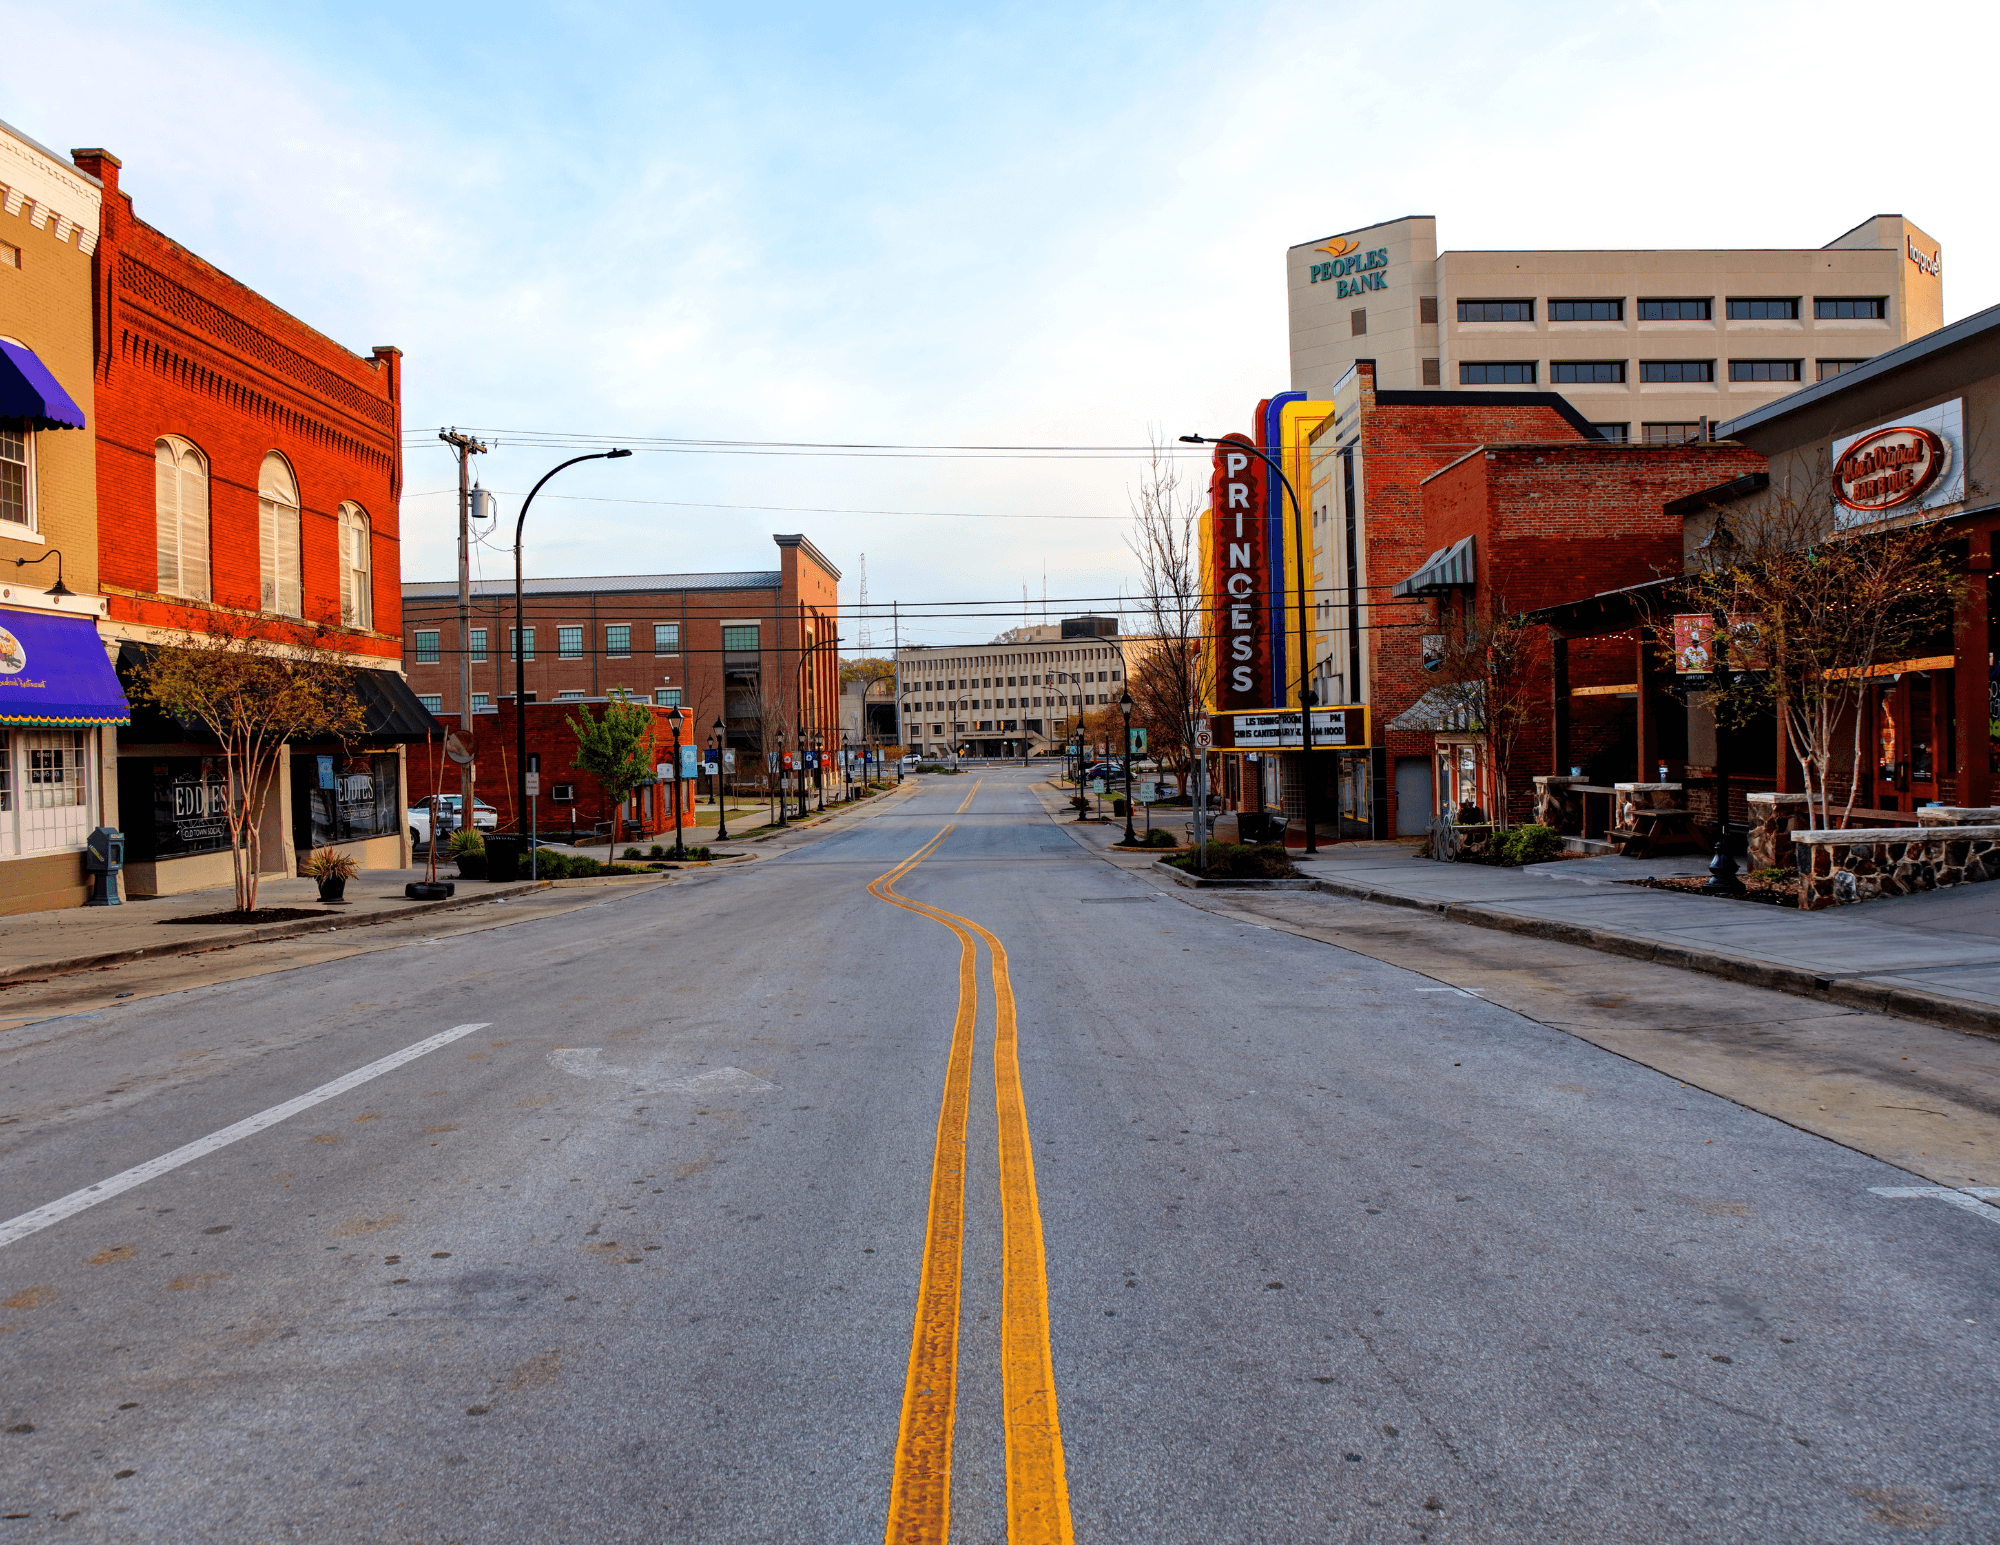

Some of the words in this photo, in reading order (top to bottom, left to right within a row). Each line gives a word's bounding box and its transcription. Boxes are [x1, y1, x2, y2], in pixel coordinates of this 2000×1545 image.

[1310, 247, 1388, 284] PEOPLES
[1336, 269, 1389, 299] BANK
[1843, 452, 1875, 484] Moe's
[1874, 439, 1924, 471] Original
[1854, 480, 1877, 501] BAR
[1877, 476, 1889, 495] B
[1888, 468, 1915, 493] QUE
[1227, 452, 1253, 692] PRINCESS
[0, 677, 18, 687] eafood
[1234, 729, 1252, 738] CHRIS
[1253, 727, 1295, 737] CANTERBURY
[1324, 727, 1344, 736] HOOD
[1283, 715, 1302, 724] ROOM
[1330, 713, 1341, 722] PM
[175, 784, 228, 816] EDDIES
[338, 776, 373, 801] EDDIES
[185, 829, 193, 837] OLD
[194, 828, 207, 837] TOWN
[207, 826, 221, 835] SOCIAL
